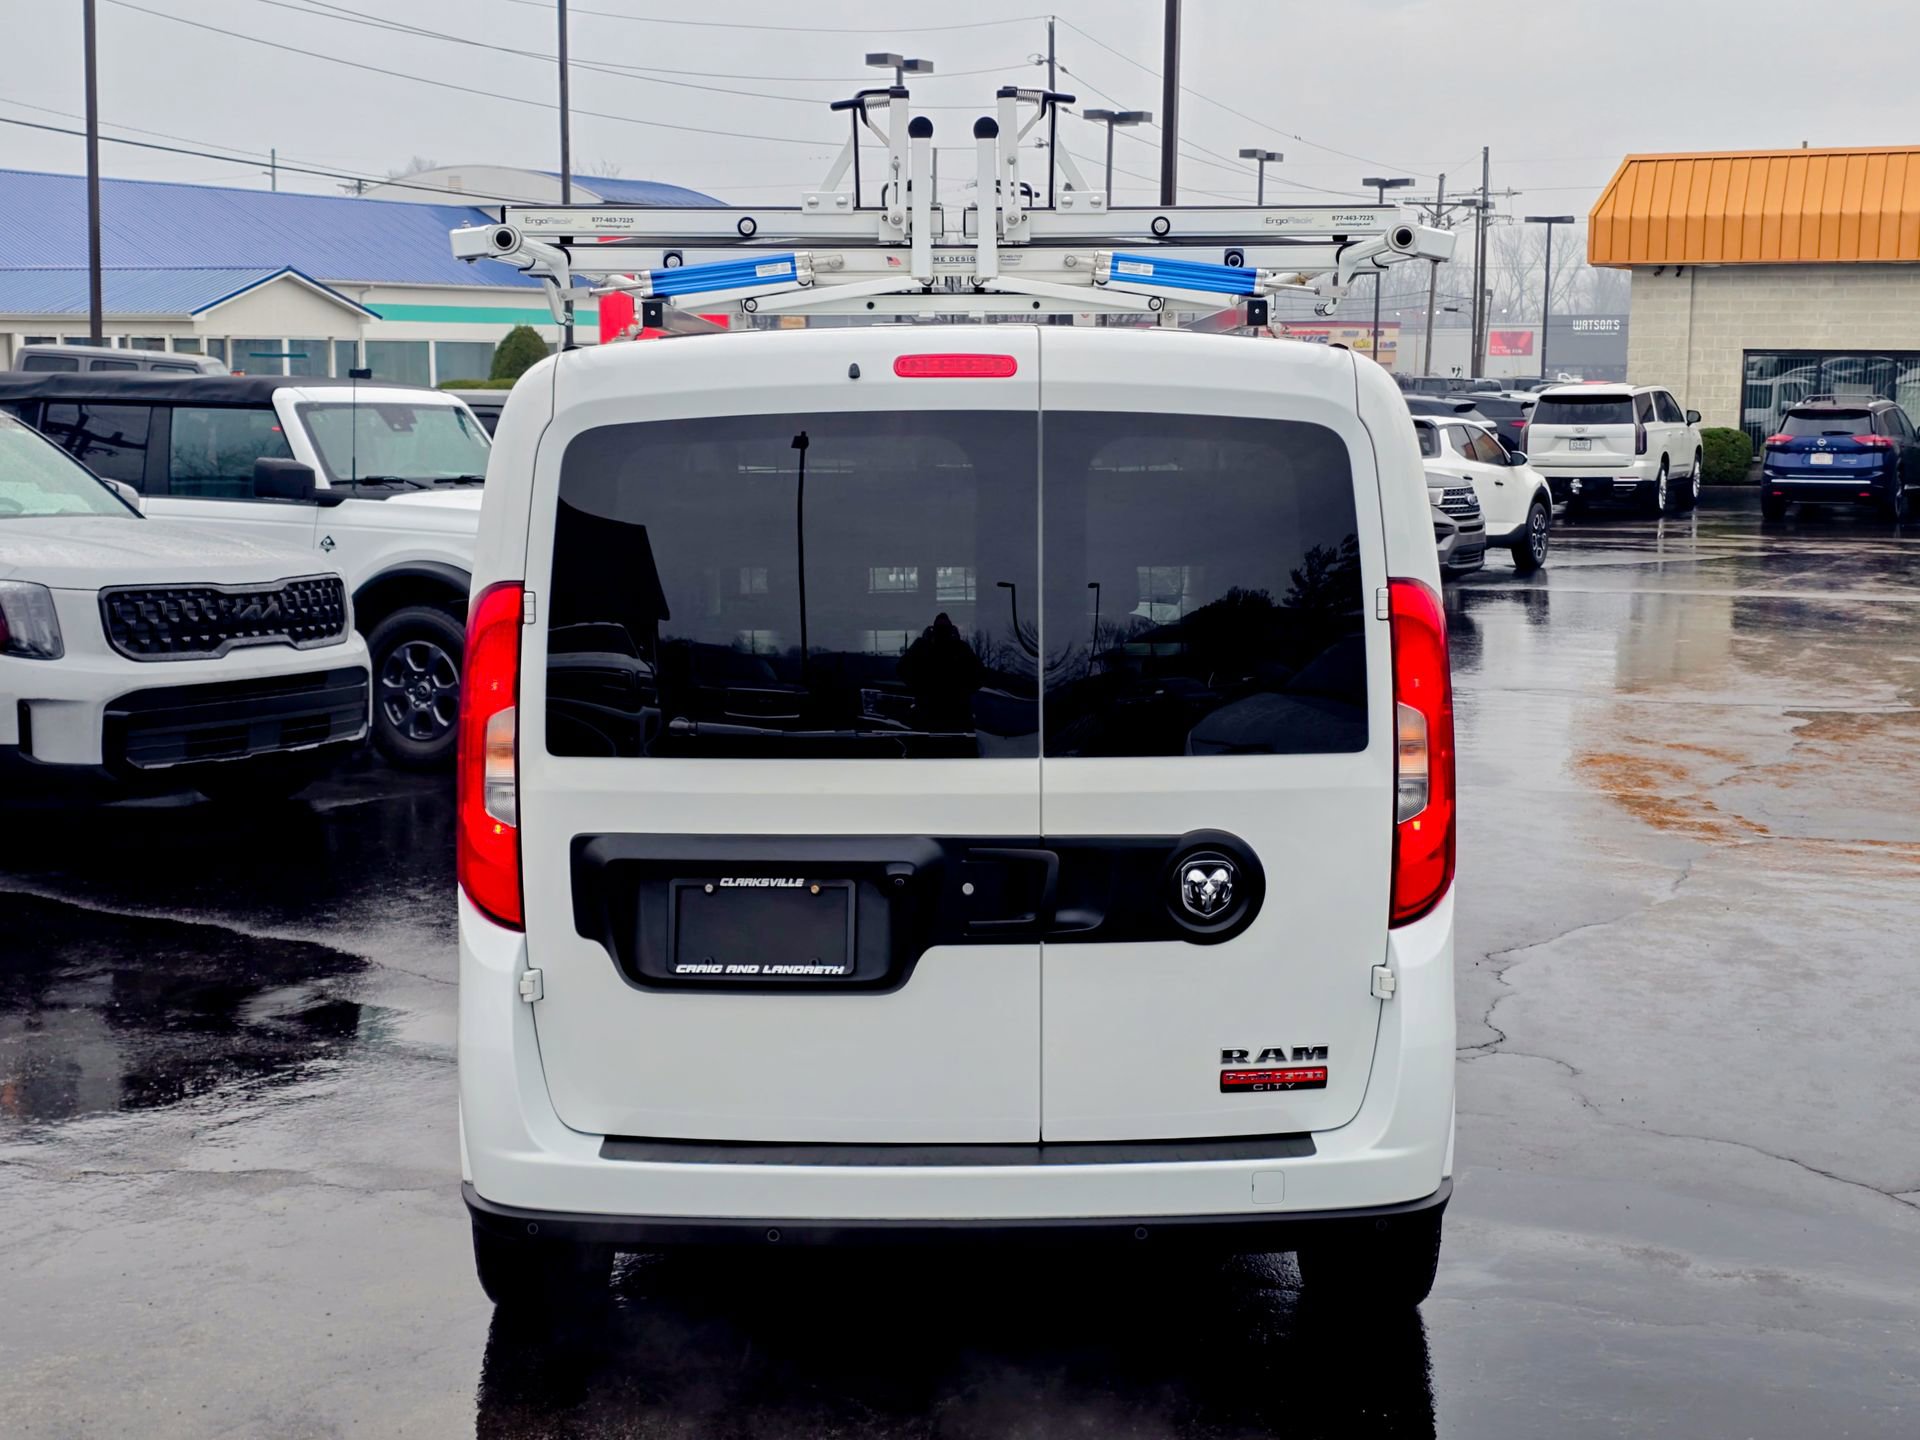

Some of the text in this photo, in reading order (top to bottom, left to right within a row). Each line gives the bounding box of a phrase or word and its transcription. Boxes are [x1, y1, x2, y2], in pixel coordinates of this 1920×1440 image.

[1572, 319, 1621, 331] WATSON'S
[719, 877, 805, 888] CLARKSVILLE
[675, 964, 846, 975] CRAIG AND LANDRETH
[1221, 1045, 1328, 1064] RAM
[1252, 1082, 1296, 1091] CITY
